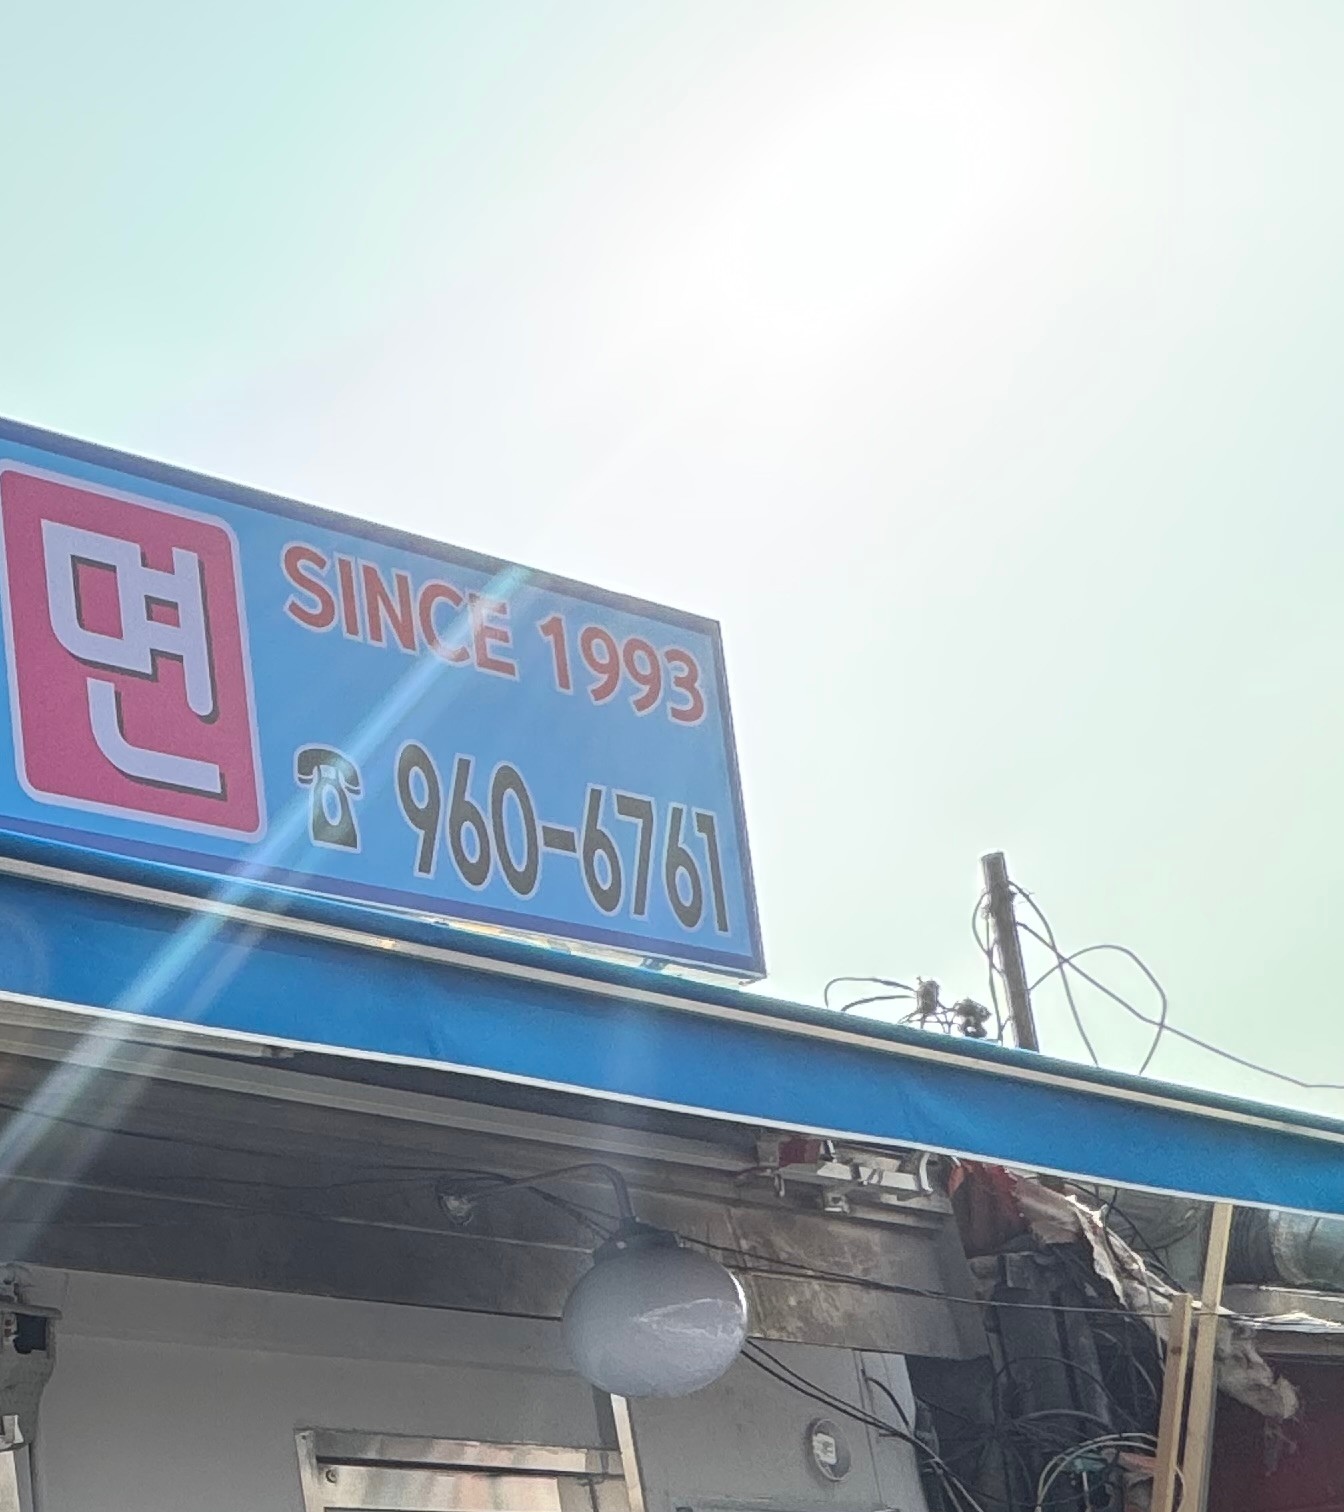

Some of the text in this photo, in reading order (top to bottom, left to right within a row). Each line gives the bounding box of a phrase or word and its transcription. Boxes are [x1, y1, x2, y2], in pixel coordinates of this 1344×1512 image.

[282, 543, 708, 726] SINCE 1993
[395, 741, 731, 937] 960-6761
